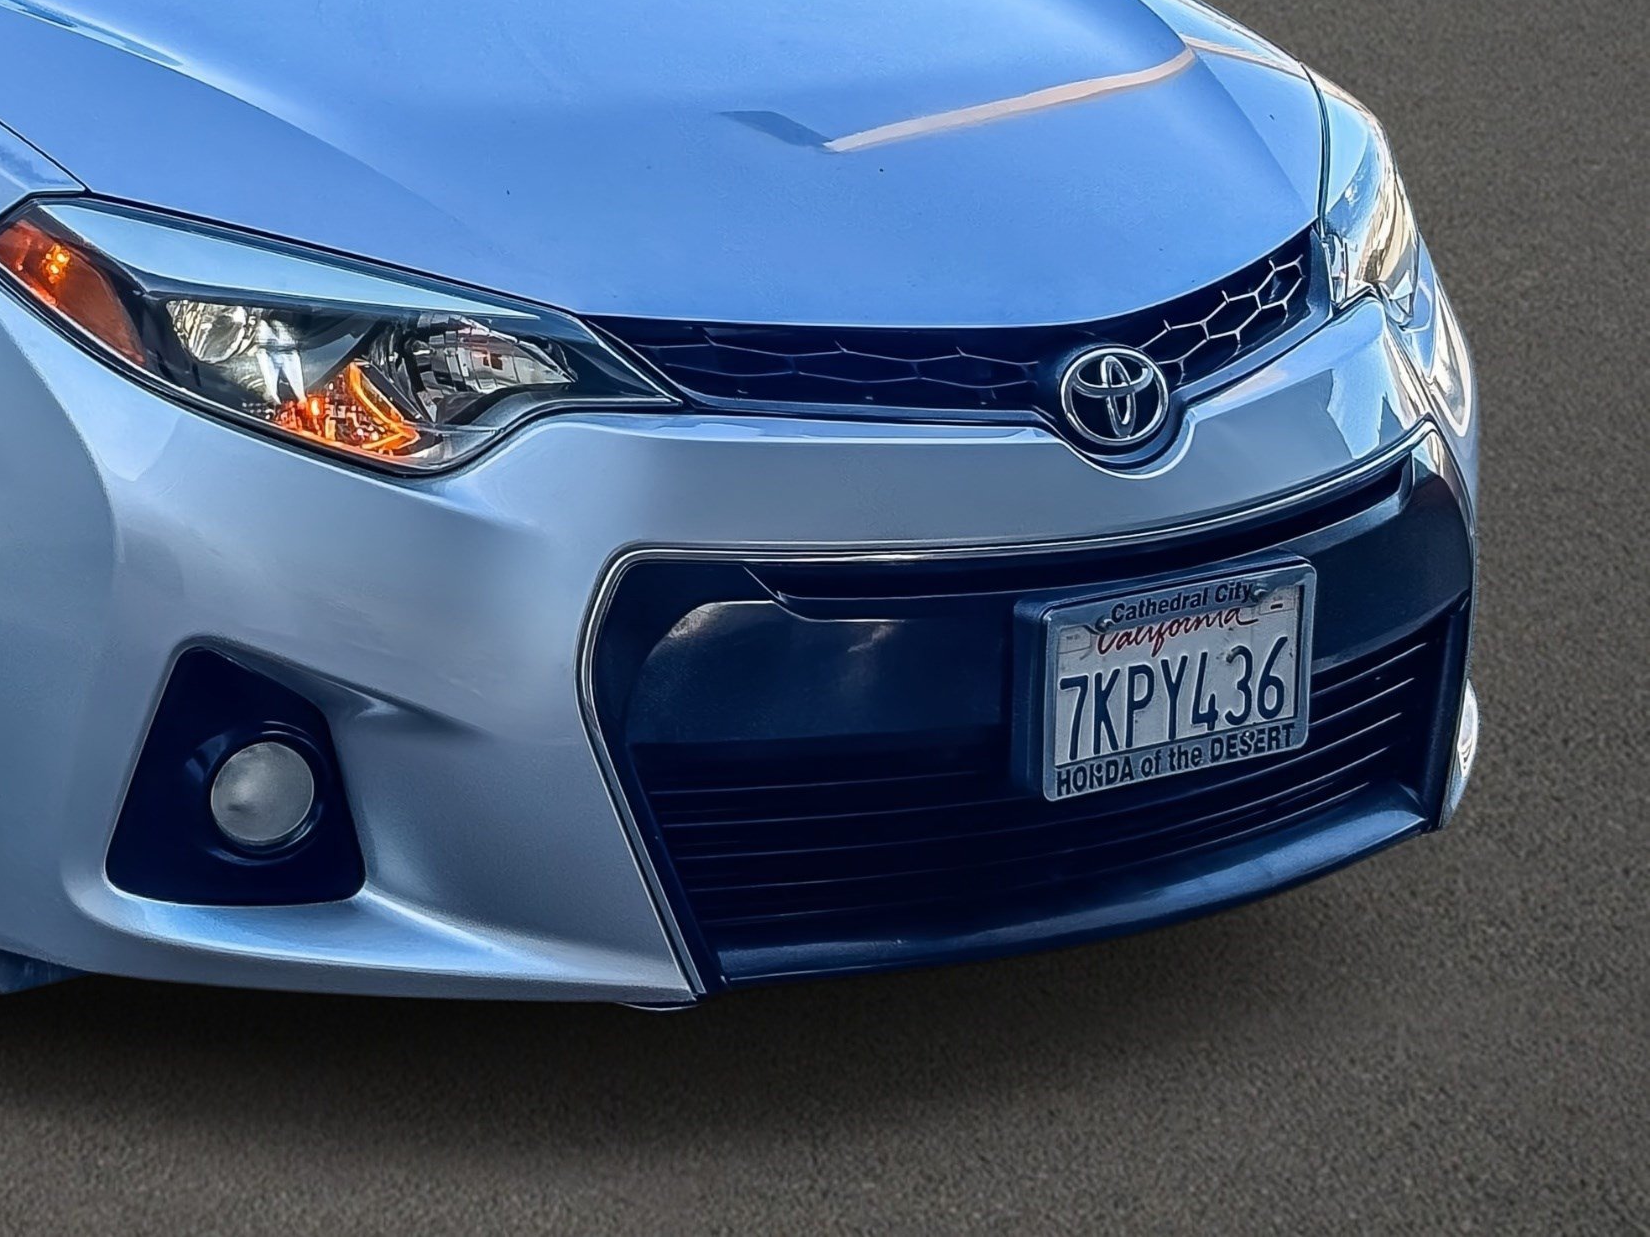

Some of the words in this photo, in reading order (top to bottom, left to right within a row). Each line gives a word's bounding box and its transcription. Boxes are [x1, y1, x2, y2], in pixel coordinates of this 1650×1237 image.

[1111, 587, 1208, 622] Cathedral
[1213, 582, 1255, 604] City
[1060, 636, 1288, 761] 7KPY436
[1056, 763, 1134, 796] HONDA
[1141, 754, 1162, 778] of
[1168, 744, 1202, 771] the
[1210, 723, 1295, 757] DESERT
